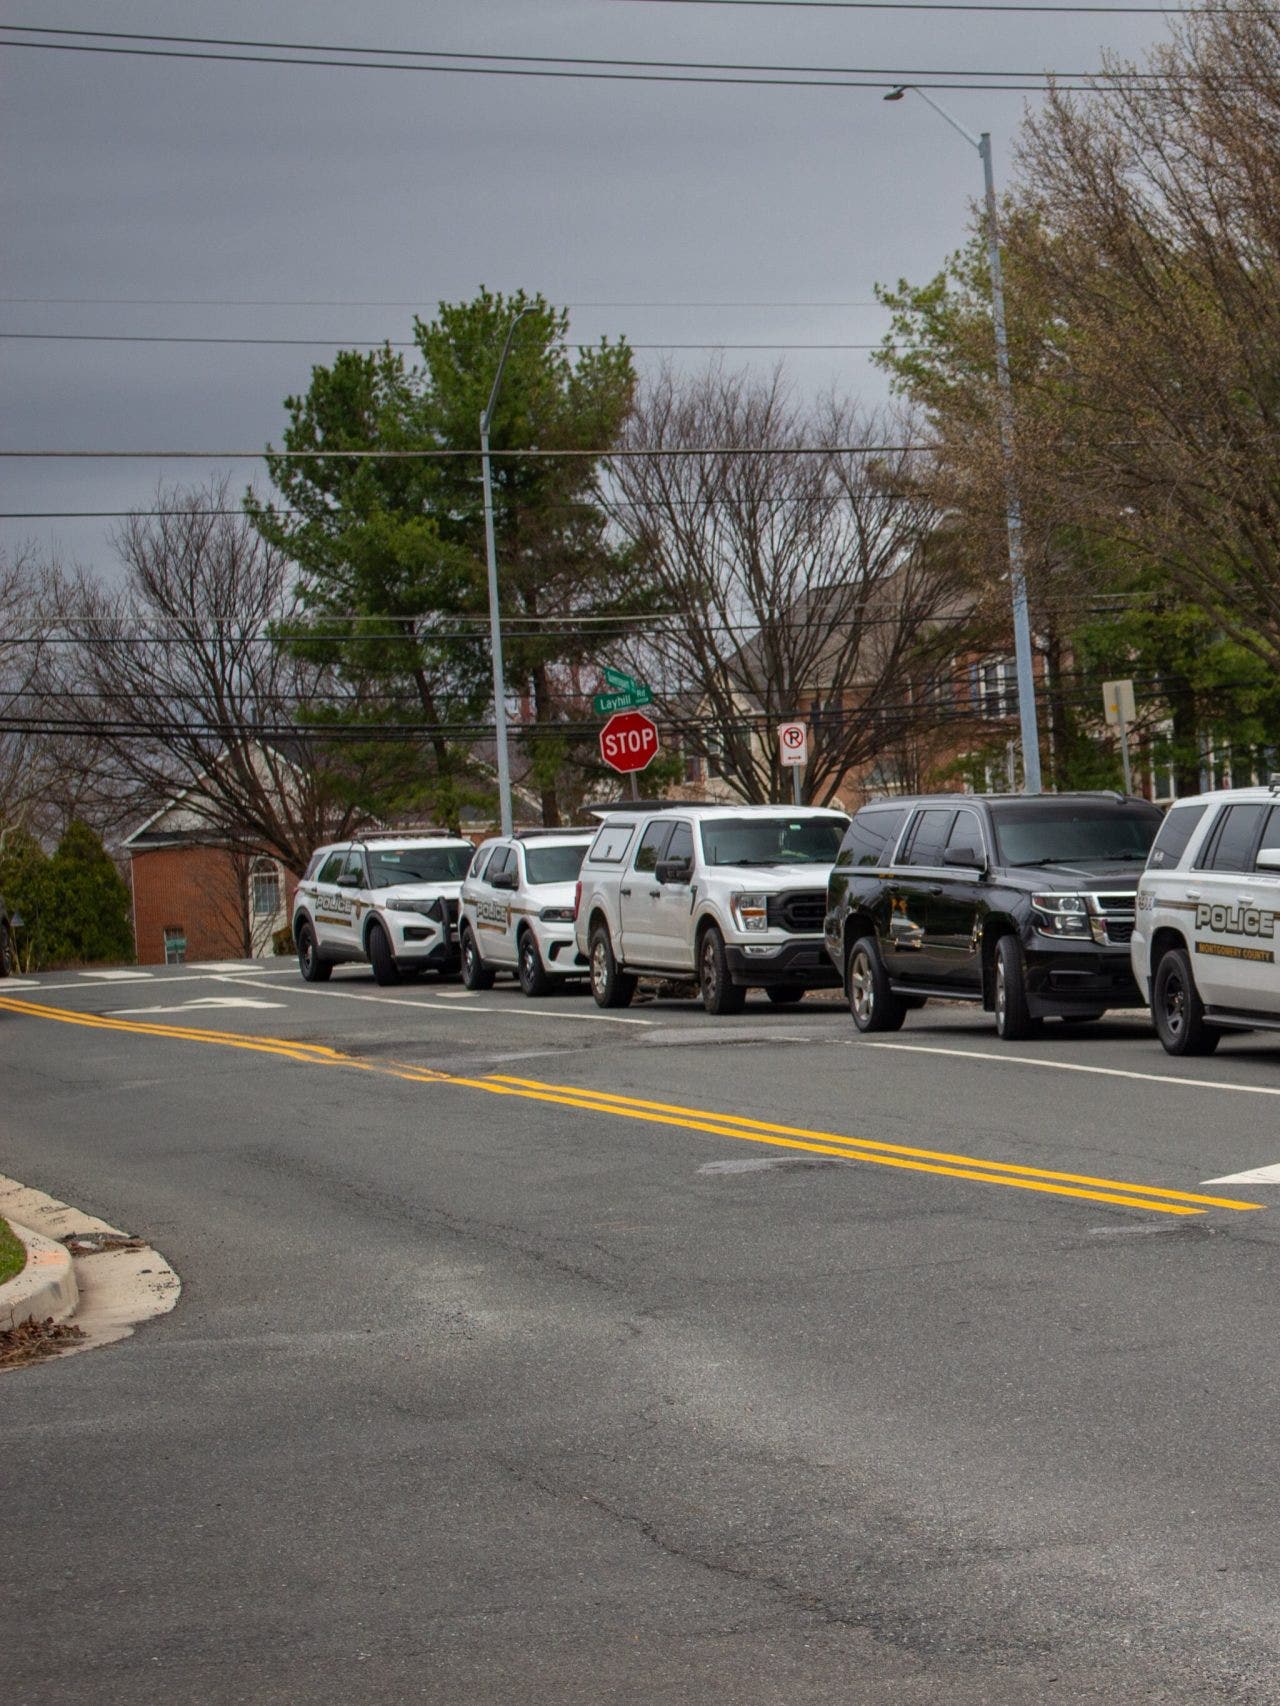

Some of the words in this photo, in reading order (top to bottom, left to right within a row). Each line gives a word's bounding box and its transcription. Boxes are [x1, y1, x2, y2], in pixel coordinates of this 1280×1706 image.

[600, 694, 631, 710] Layhill
[605, 727, 654, 757] STOP
[315, 894, 352, 915] POLICE
[476, 901, 507, 923] POLICE
[1195, 903, 1275, 939] POLICE
